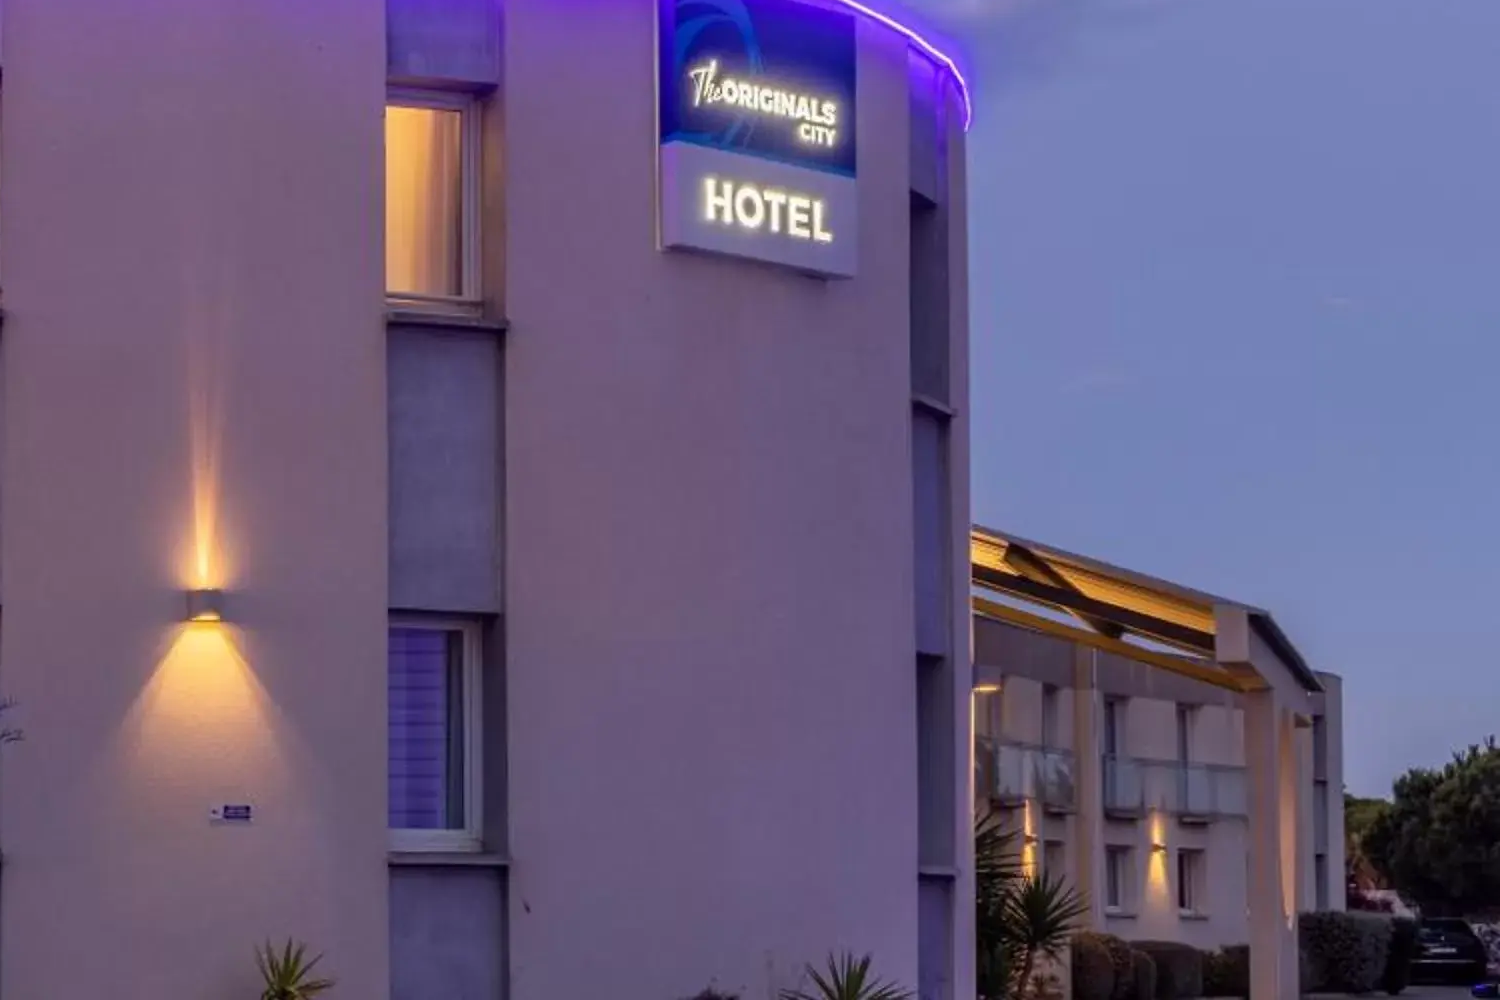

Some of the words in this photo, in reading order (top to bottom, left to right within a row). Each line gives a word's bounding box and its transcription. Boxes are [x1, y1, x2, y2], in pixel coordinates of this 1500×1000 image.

[690, 60, 722, 107] The
[721, 80, 836, 126] ORIGINALS
[800, 124, 836, 147] CITY
[704, 178, 833, 242] HOTEL
